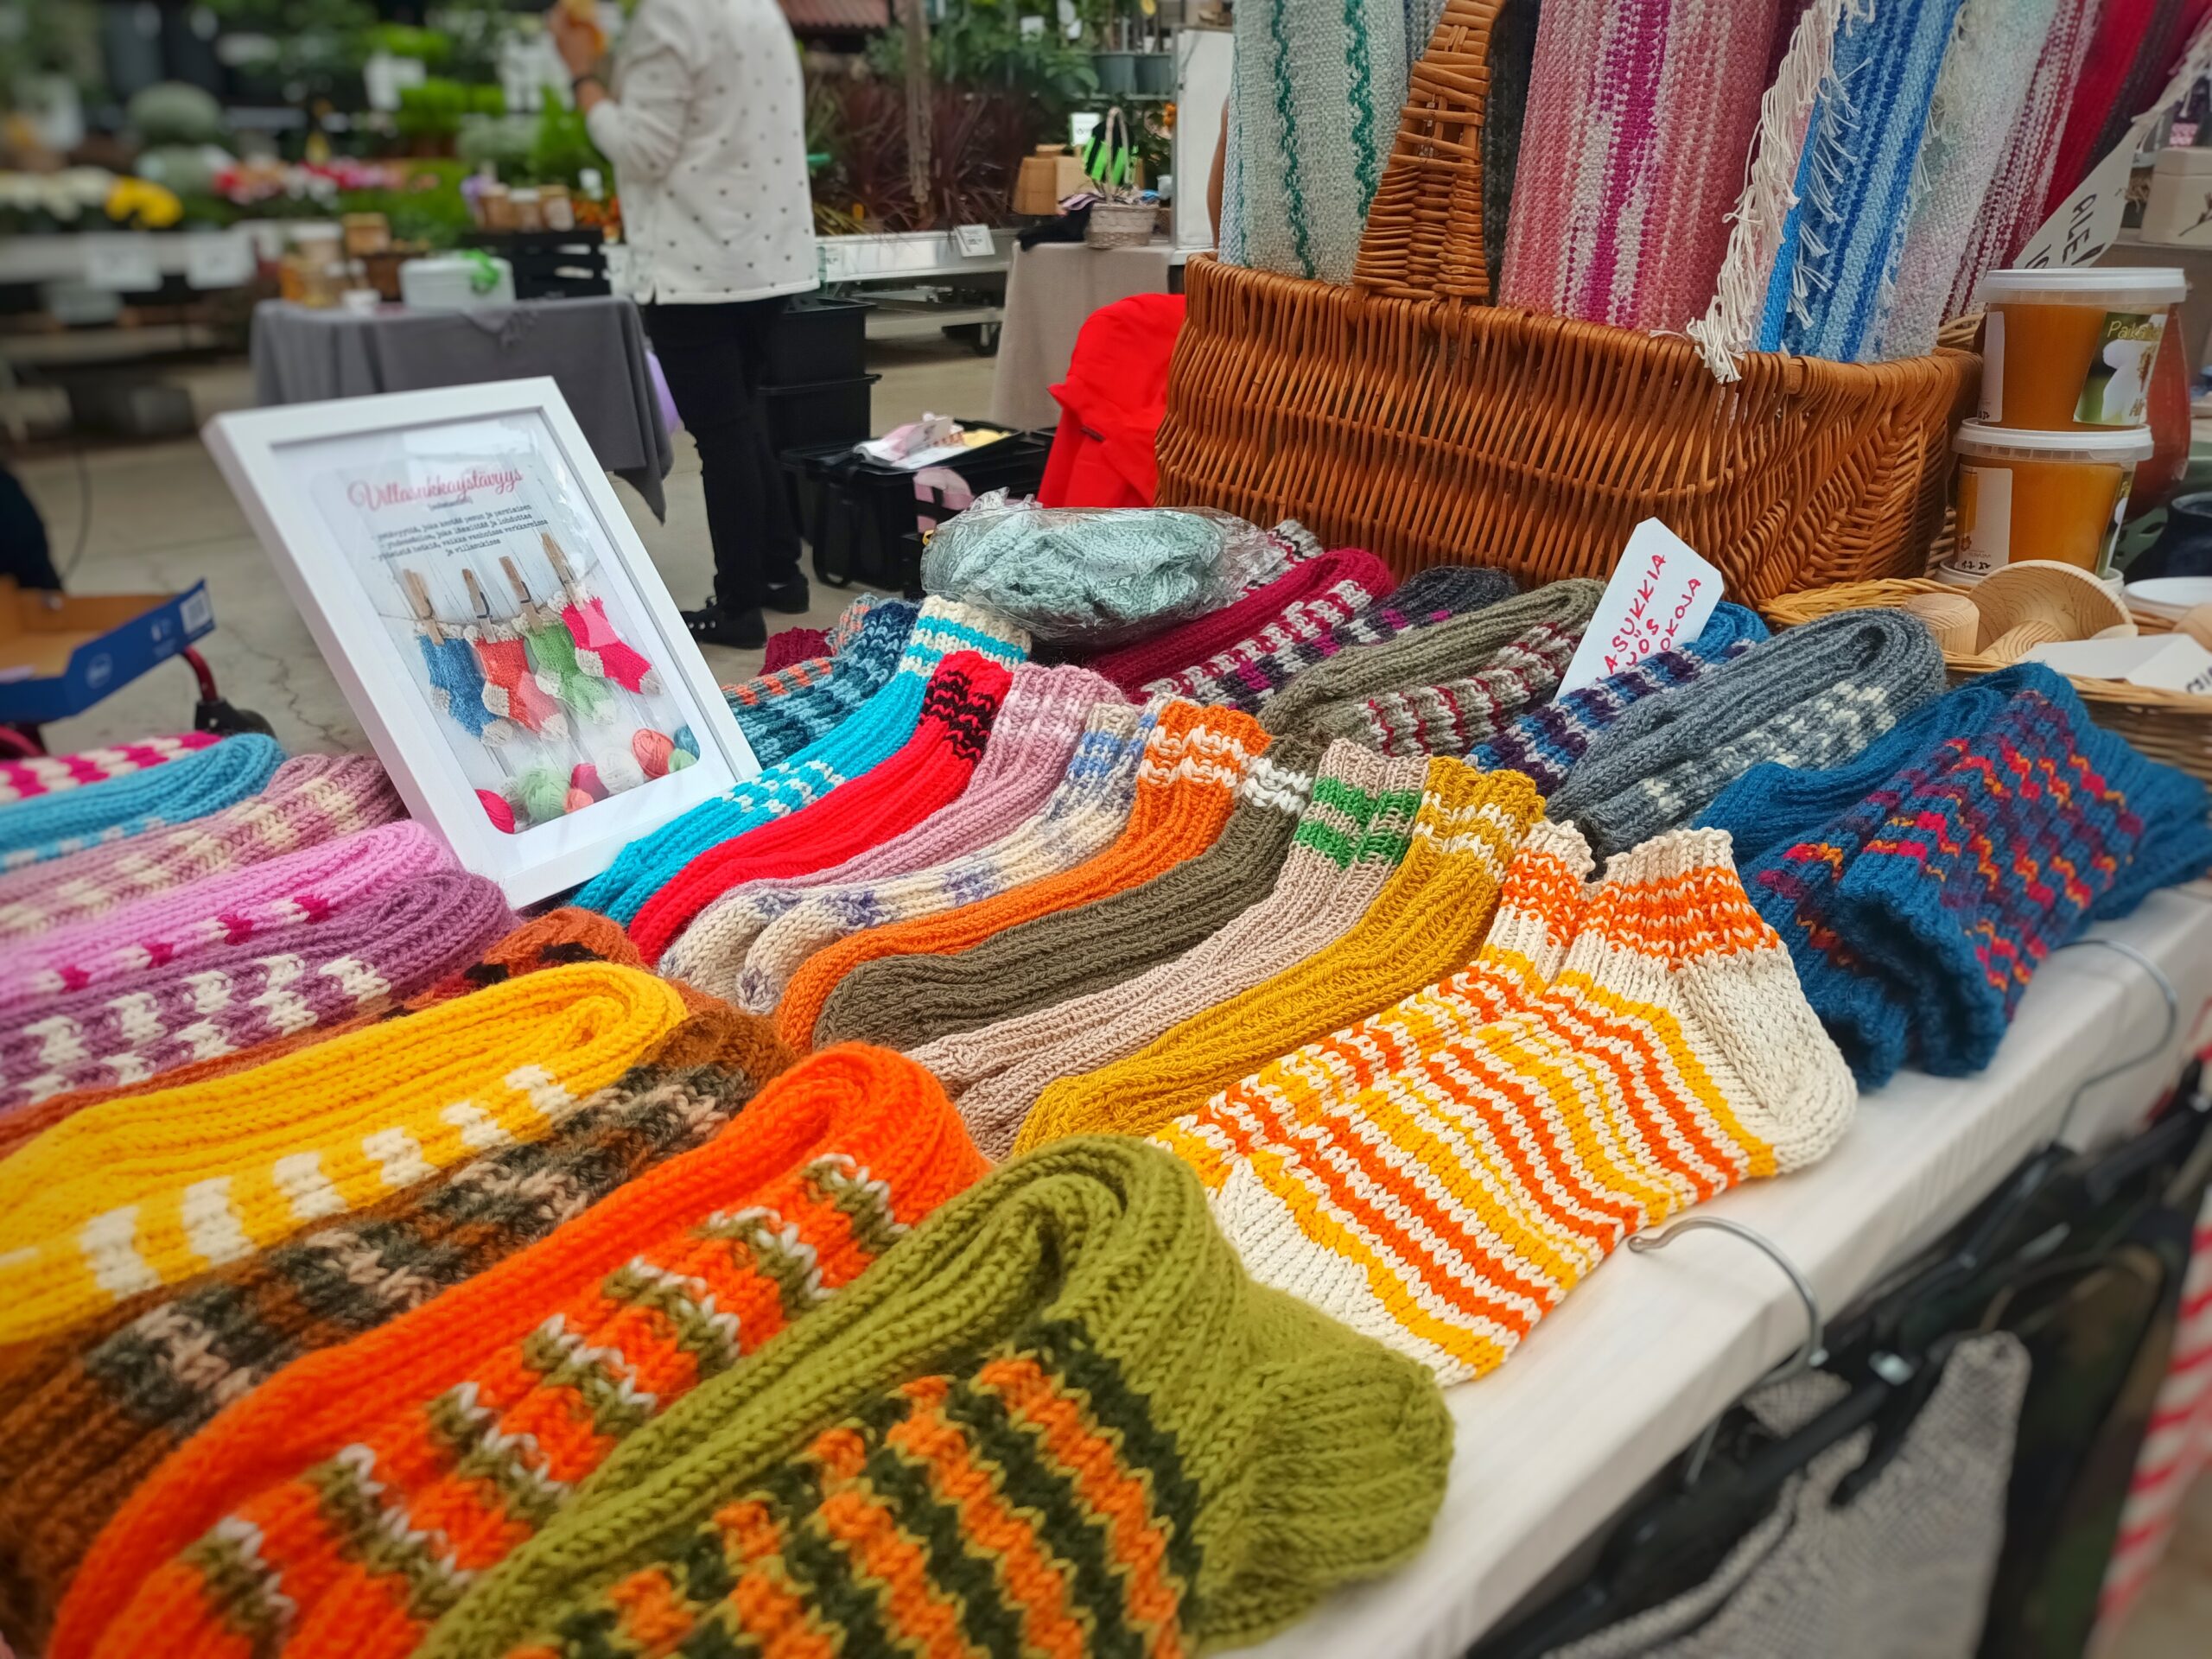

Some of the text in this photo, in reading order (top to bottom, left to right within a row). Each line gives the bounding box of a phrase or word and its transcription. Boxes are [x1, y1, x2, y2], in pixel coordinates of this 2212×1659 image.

[347, 467, 523, 512] Villasukkaystävyys
[442, 534, 467, 547] vaikka
[444, 537, 501, 557] ja villasukissa
[1596, 555, 1666, 681] ASUKKIA
